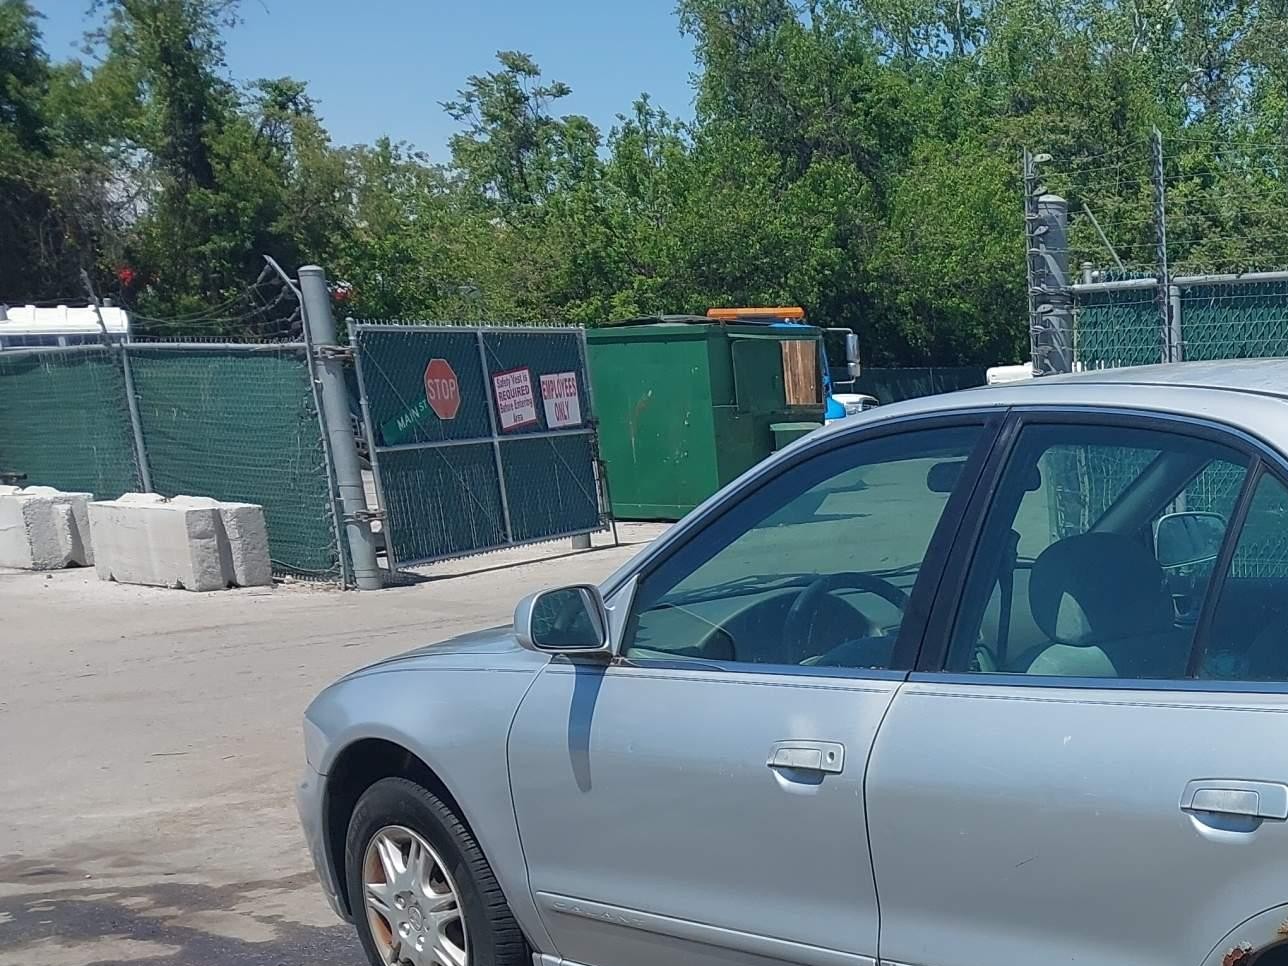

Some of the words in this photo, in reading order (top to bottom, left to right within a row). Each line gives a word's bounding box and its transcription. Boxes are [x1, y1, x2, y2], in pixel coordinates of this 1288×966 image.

[427, 378, 456, 400] STOP
[496, 375, 511, 388] Safety
[510, 374, 522, 385] Vest
[521, 373, 528, 383] is
[541, 377, 577, 400] EMPLOYEES
[498, 384, 530, 402] REQUIRED
[396, 405, 420, 431] MAIN
[418, 399, 428, 412] ST
[499, 400, 514, 413] Before
[513, 398, 533, 411] Entering
[554, 400, 570, 422] ONLY
